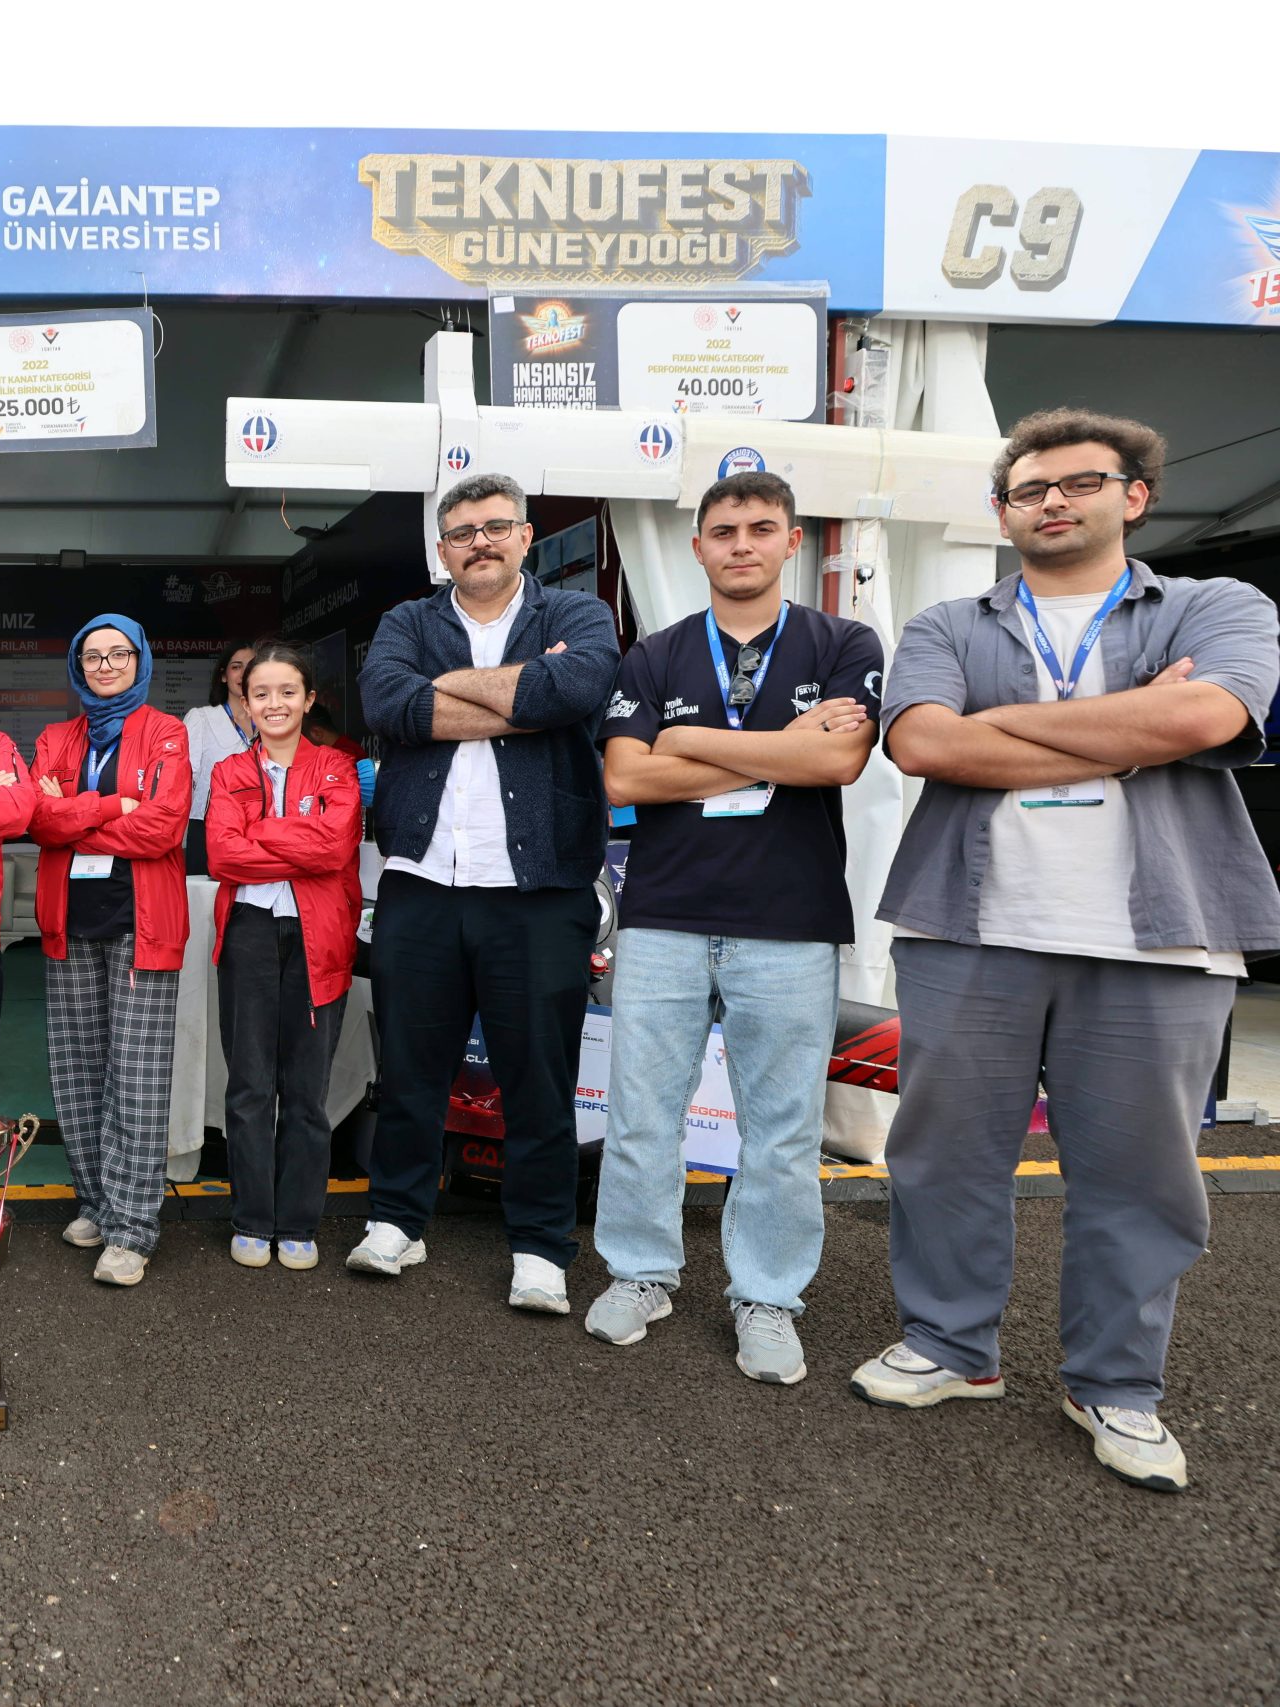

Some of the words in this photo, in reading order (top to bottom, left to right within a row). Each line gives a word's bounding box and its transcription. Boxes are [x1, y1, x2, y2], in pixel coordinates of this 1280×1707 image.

[2, 177, 220, 217] GAZİANTEP
[367, 157, 803, 226] TEKNOFEST
[3, 220, 220, 251] ÜNİVERSİTESİ
[942, 184, 1084, 290] C9
[453, 226, 737, 267] GÜNEYDOĞU
[526, 325, 586, 350] TEKNOFEST
[706, 339, 731, 349] 2022
[22, 360, 49, 370] 2022
[672, 354, 696, 362] FIXED
[698, 354, 721, 362] WING
[722, 354, 765, 363] CATEGORY
[8, 375, 38, 384] KANAT
[40, 370, 91, 382] KATEGORİSİ
[648, 365, 709, 374] PERFORMANCE
[711, 365, 741, 374] AWARD
[742, 365, 764, 374] FIRST
[766, 366, 789, 374] PRIZE
[17, 383, 63, 395] BİRİNCİLİK
[64, 381, 95, 392] ÖDÜLÜ
[514, 387, 542, 402] HAVA
[677, 378, 744, 396] 40.000
[250, 585, 272, 595] 2026
